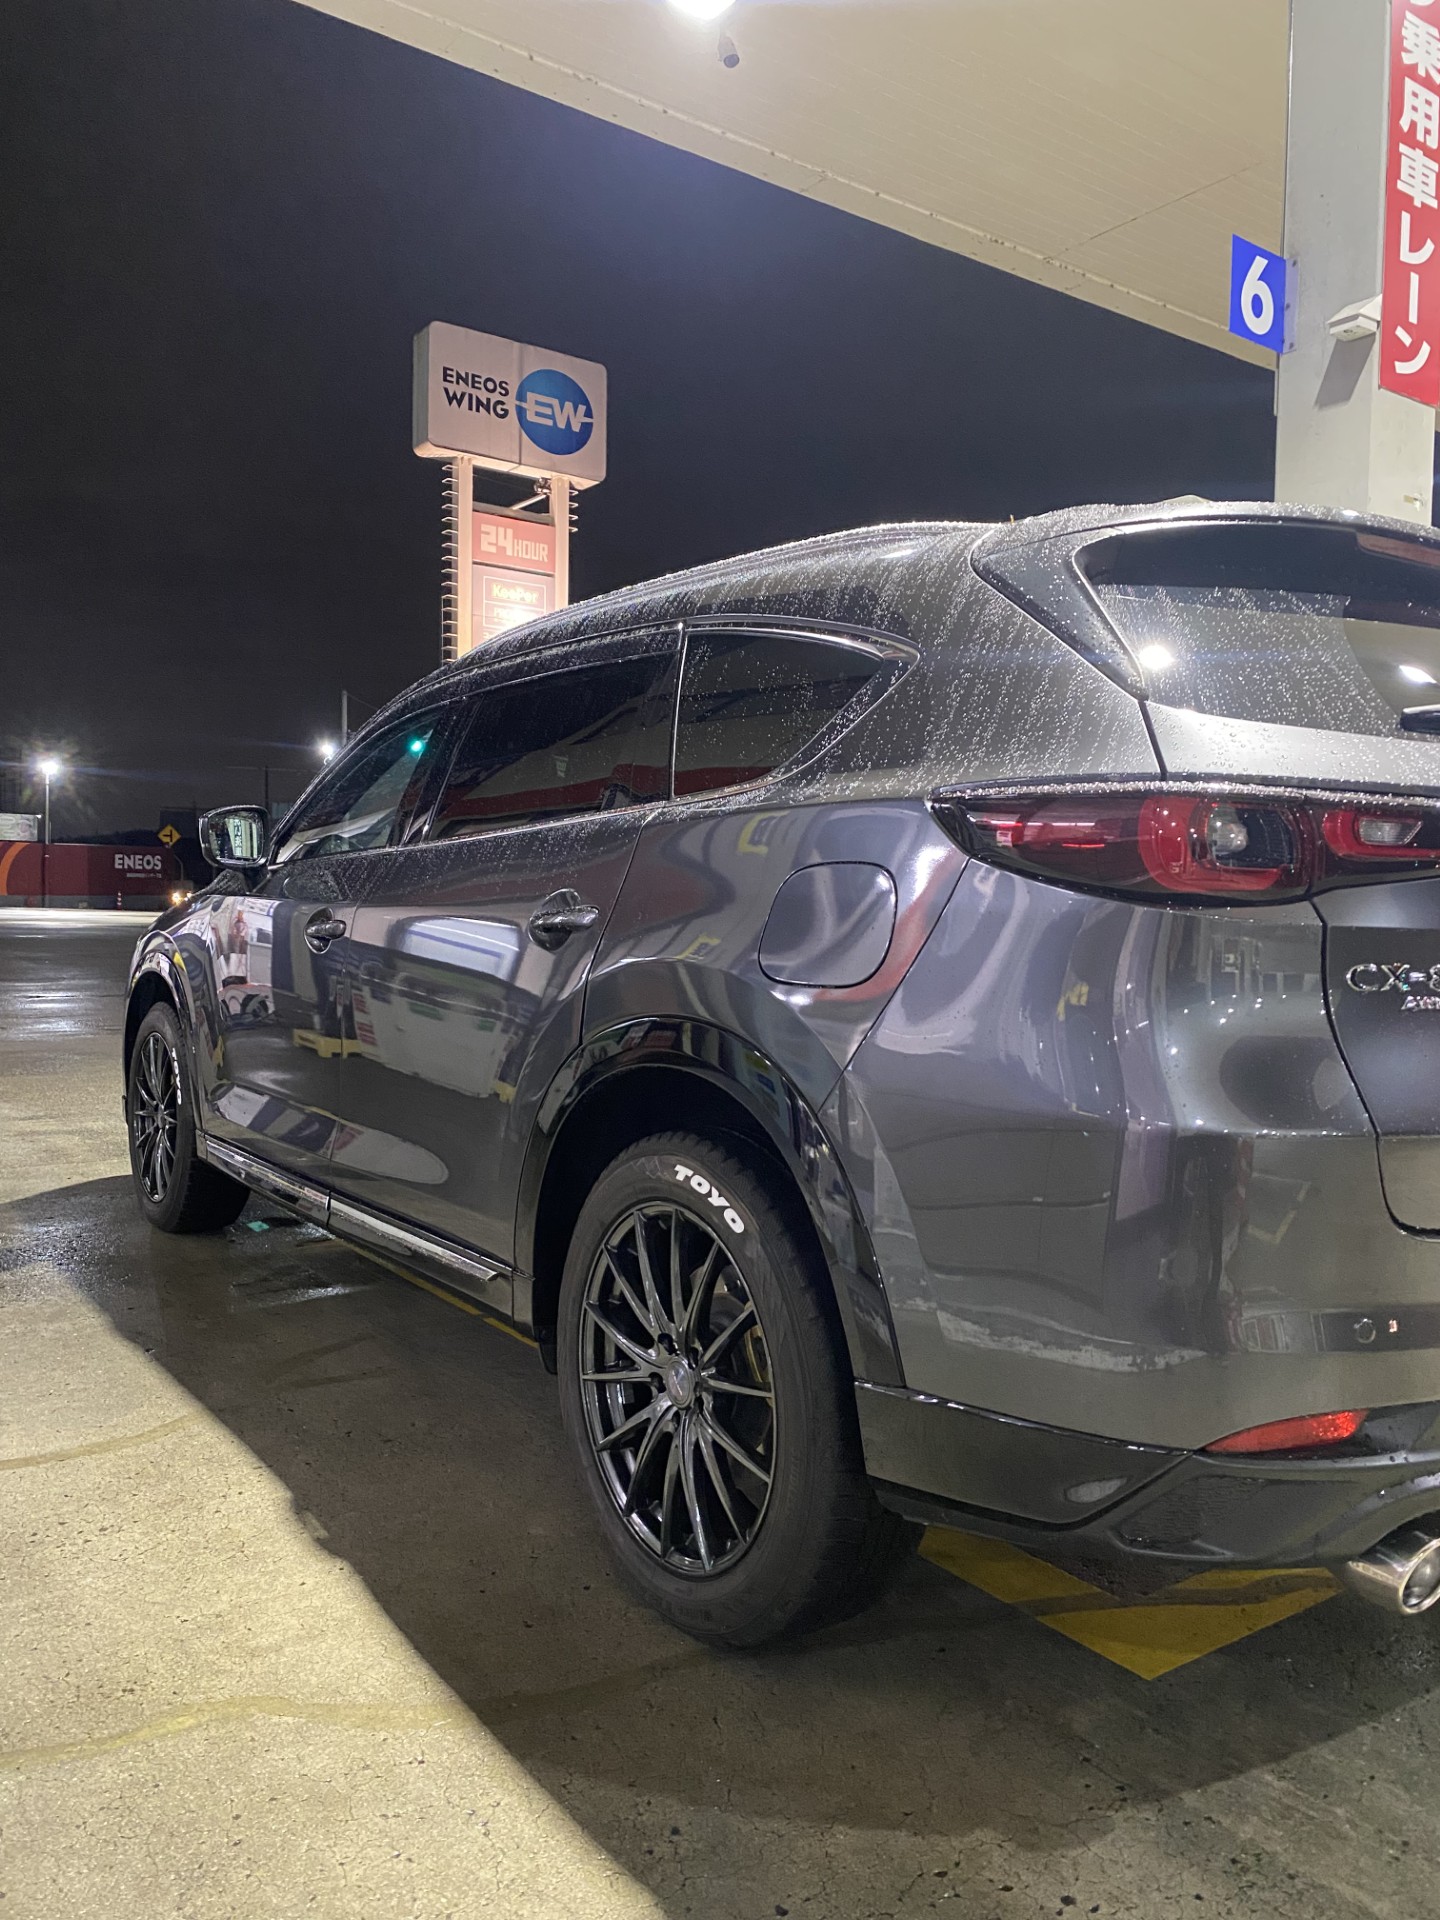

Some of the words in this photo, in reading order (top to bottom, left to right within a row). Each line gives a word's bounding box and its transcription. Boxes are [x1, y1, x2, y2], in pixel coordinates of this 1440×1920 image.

[1394, 0, 1440, 374] 乗用車レーン
[1240, 255, 1274, 335] 6
[442, 366, 510, 397] ENEOS
[443, 386, 510, 420] WING
[526, 391, 588, 433] EW
[114, 853, 162, 870] ENEOS
[674, 1164, 745, 1234] TOYO
